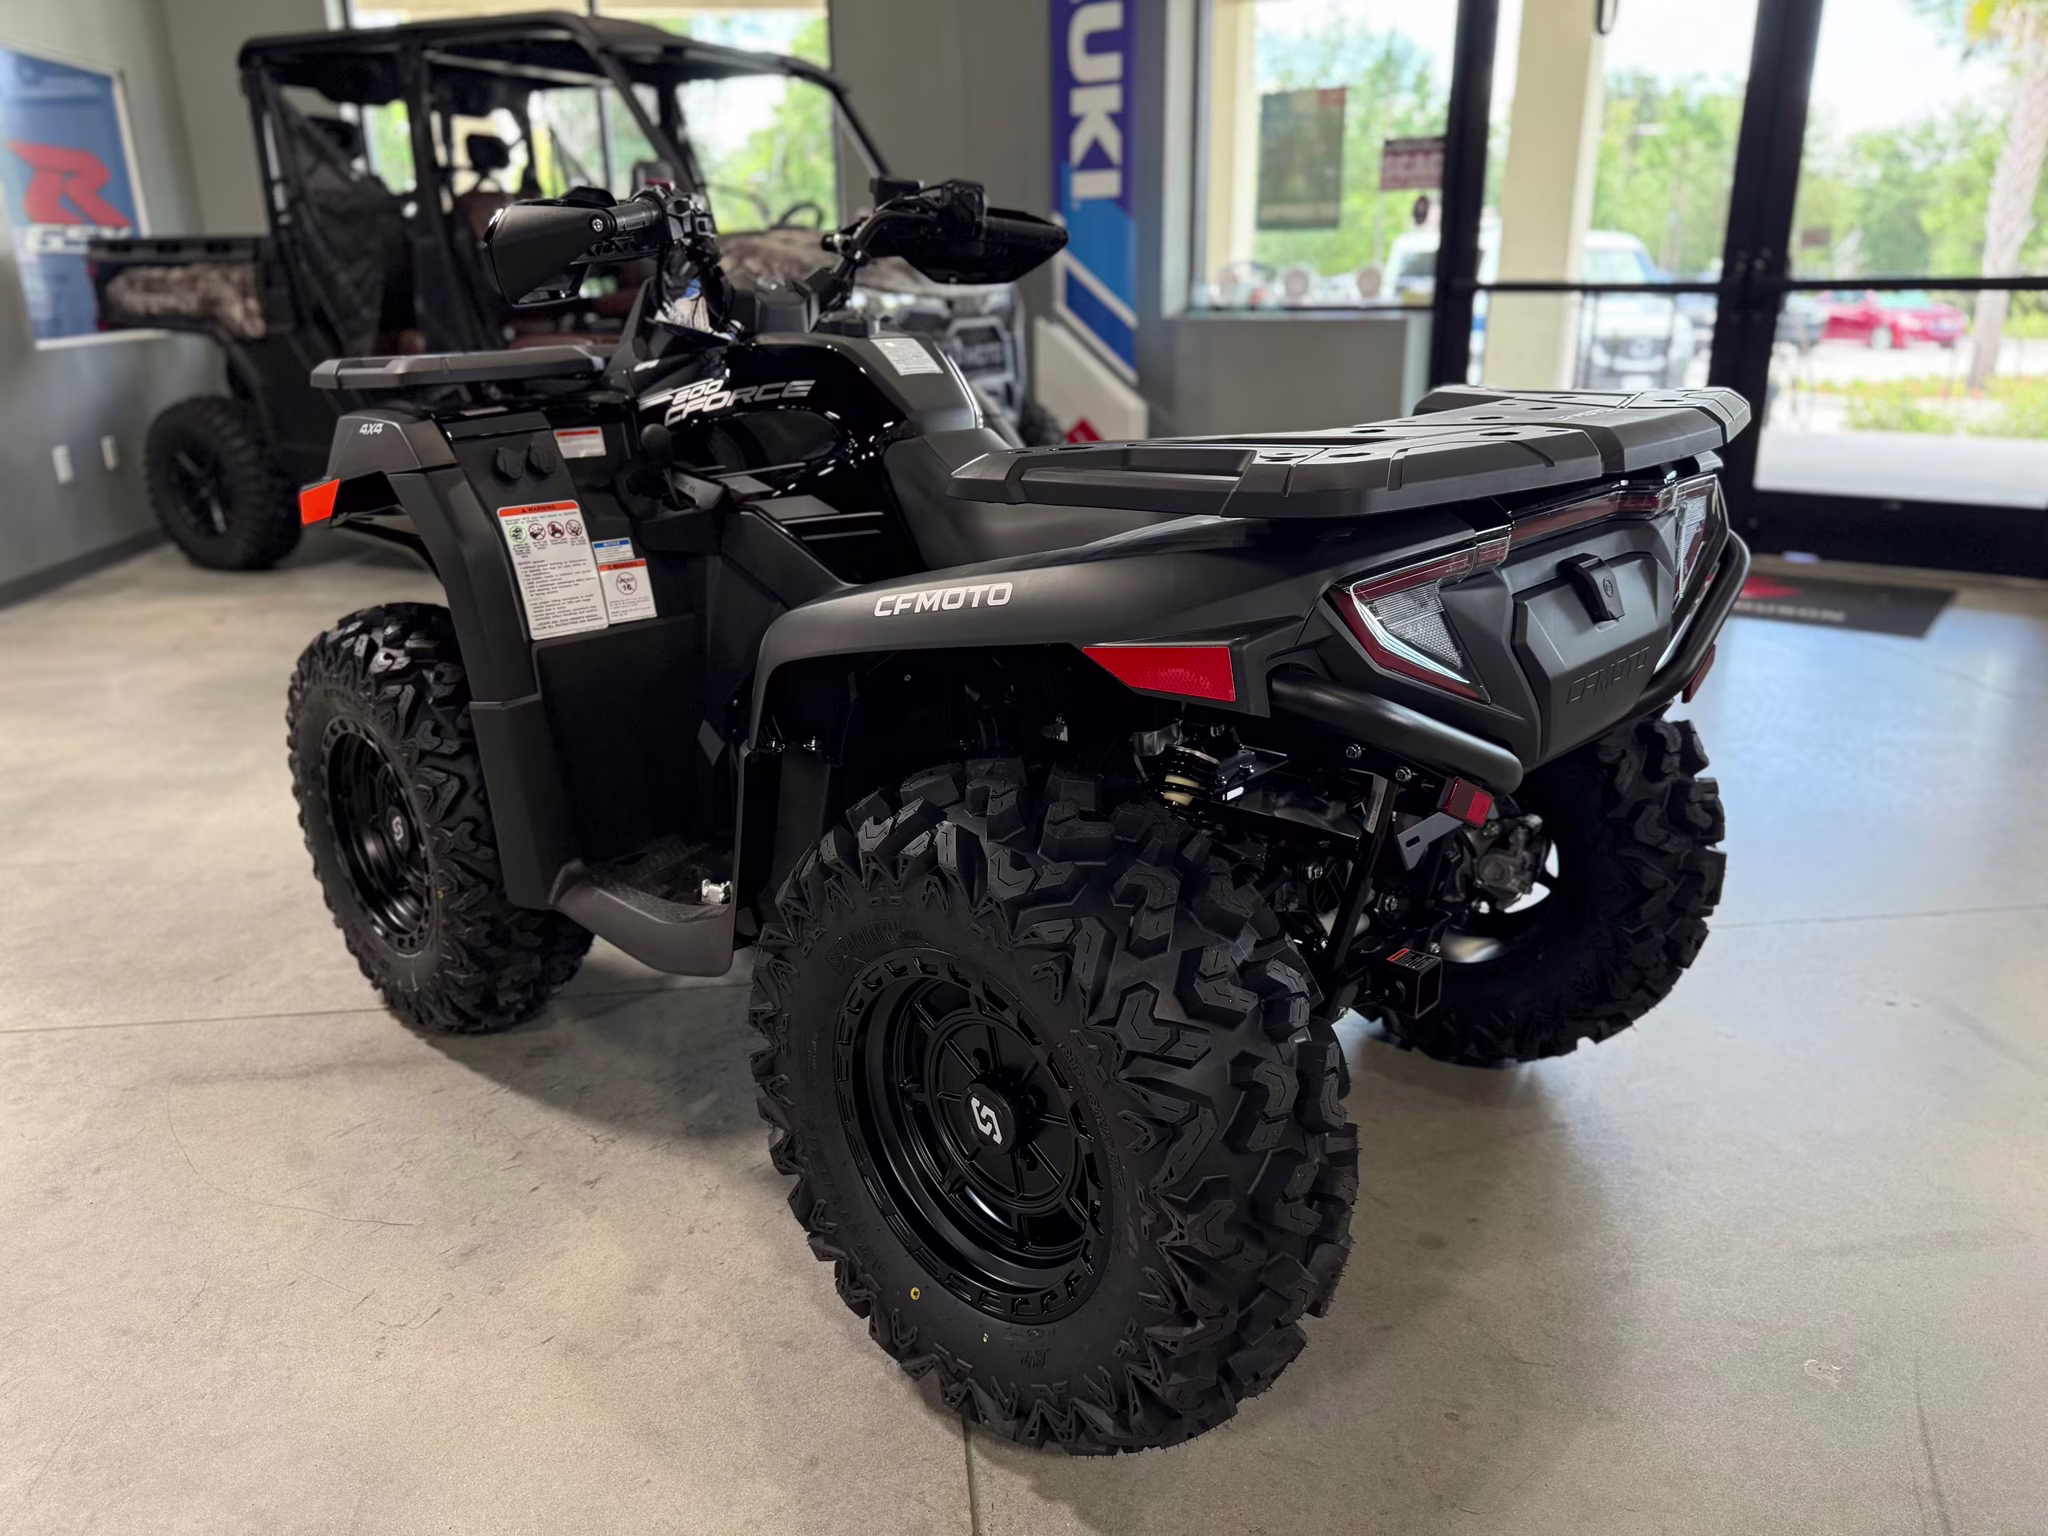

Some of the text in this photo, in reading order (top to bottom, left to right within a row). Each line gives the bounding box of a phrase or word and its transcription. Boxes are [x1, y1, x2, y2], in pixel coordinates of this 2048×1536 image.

[1067, 0, 1125, 199] UKI
[663, 380, 816, 428] CFORCE
[671, 379, 725, 406] 600
[359, 423, 385, 436] 4X4
[527, 504, 557, 513] WARNING
[873, 582, 1013, 617] CFMOTO
[1566, 645, 1650, 706] CFMOTO
